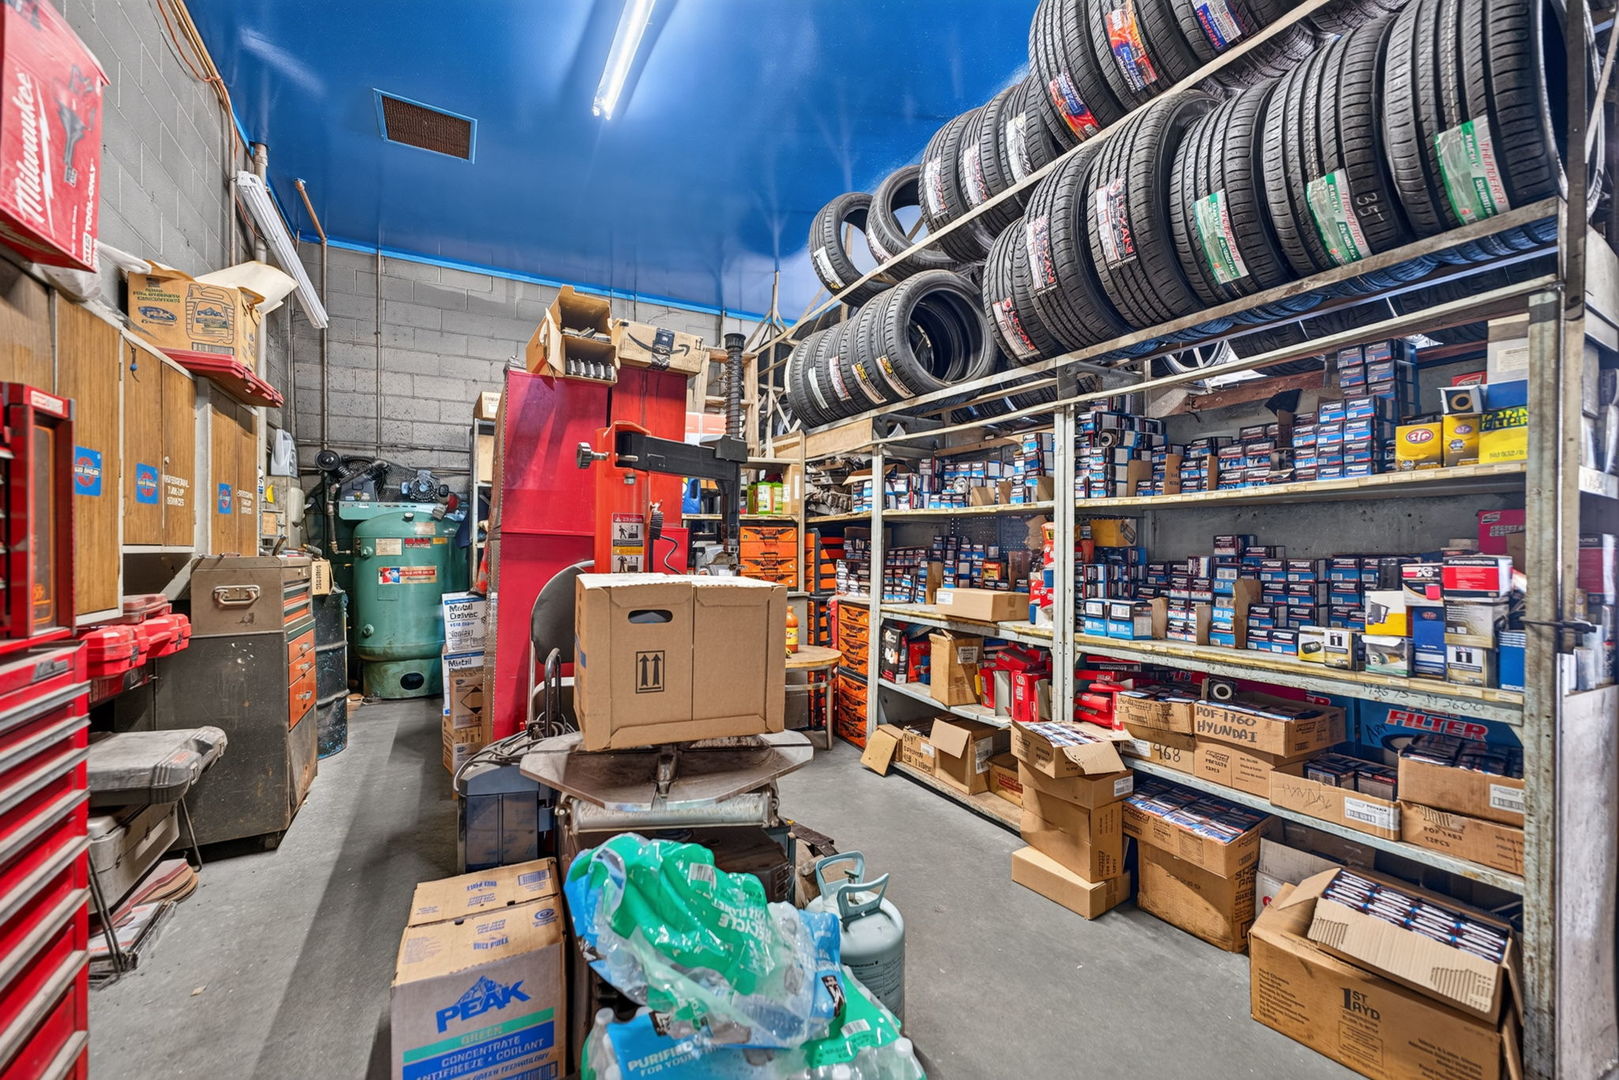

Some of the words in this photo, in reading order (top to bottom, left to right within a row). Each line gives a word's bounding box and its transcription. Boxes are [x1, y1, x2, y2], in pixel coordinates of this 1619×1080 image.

[14, 72, 46, 224] Milwaukee
[1480, 141, 1506, 204] THUNDERER
[1409, 431, 1432, 442] STP
[1196, 706, 1257, 727] POF-1760
[1196, 720, 1257, 743] HYUNDAI
[1385, 709, 1488, 742] FILTER
[718, 913, 772, 944] RECYCLE
[436, 980, 531, 1033] PEAK
[441, 1035, 521, 1067] CONCENTRATE
[496, 1038, 544, 1061] COOLANT
[641, 1064, 663, 1077] FOR
